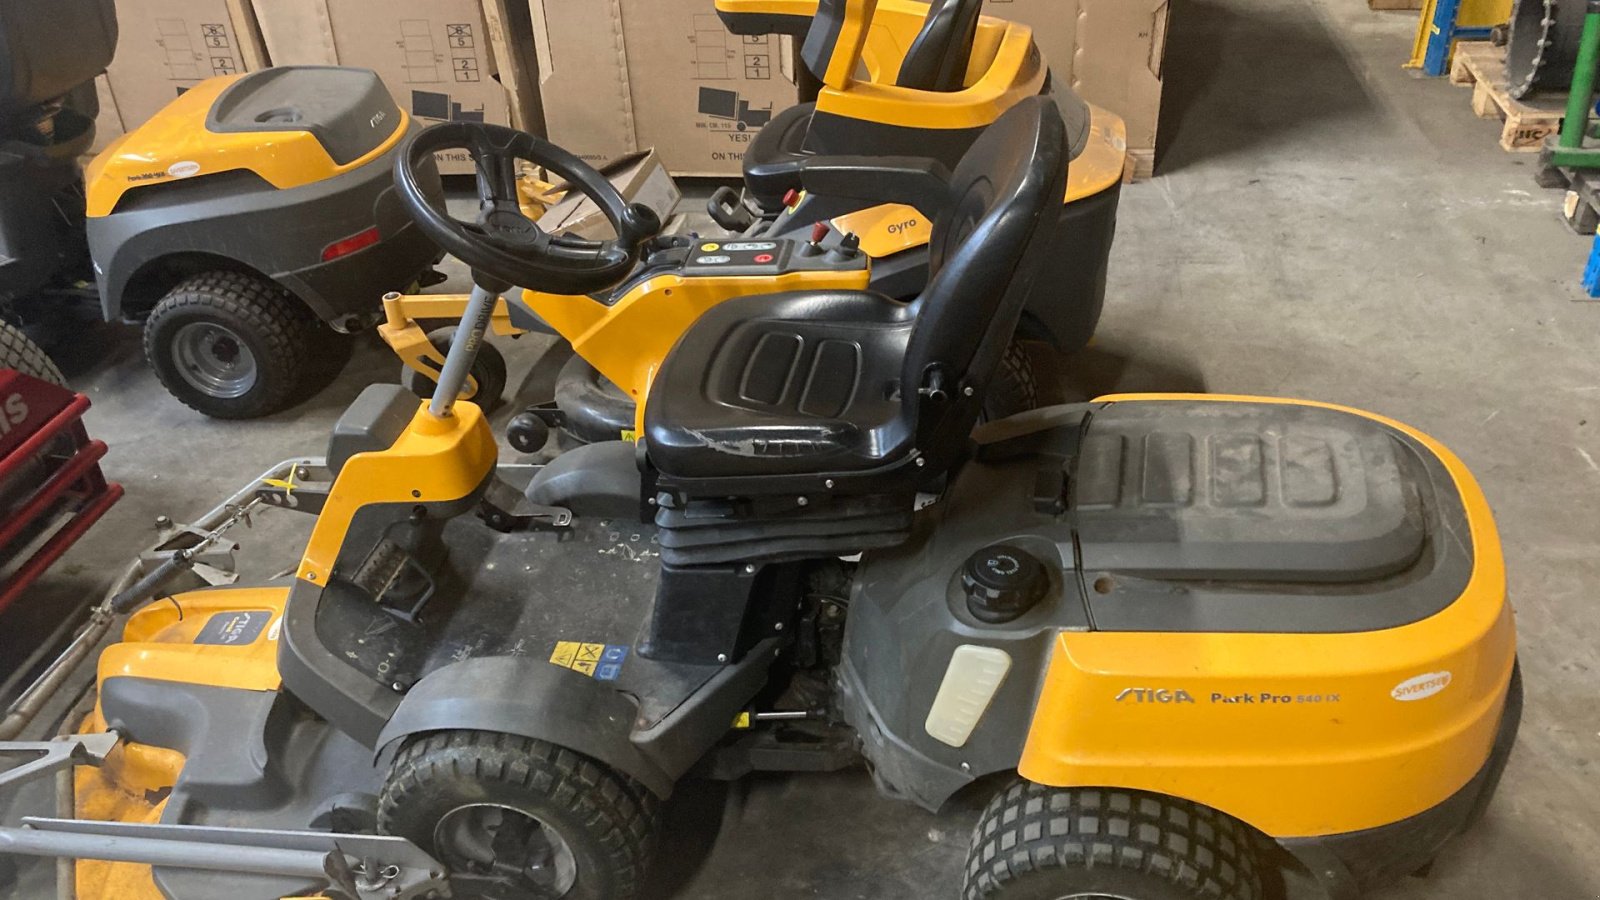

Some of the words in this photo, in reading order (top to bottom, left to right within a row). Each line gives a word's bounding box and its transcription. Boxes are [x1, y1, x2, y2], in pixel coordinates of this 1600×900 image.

[213, 37, 221, 47] 5
[457, 37, 466, 47] 5
[219, 59, 226, 67] 2
[461, 59, 469, 69] 2
[752, 56, 761, 66] 2
[463, 71, 470, 80] 1
[753, 68, 760, 77] 1
[728, 133, 752, 143] YES!
[445, 153, 466, 161] THIS
[711, 152, 726, 160] ON
[727, 152, 745, 160] THI
[887, 219, 917, 234] Gyro
[1115, 687, 1195, 704] STIGA
[1210, 692, 1254, 704] Park
[1259, 692, 1292, 704] Pro
